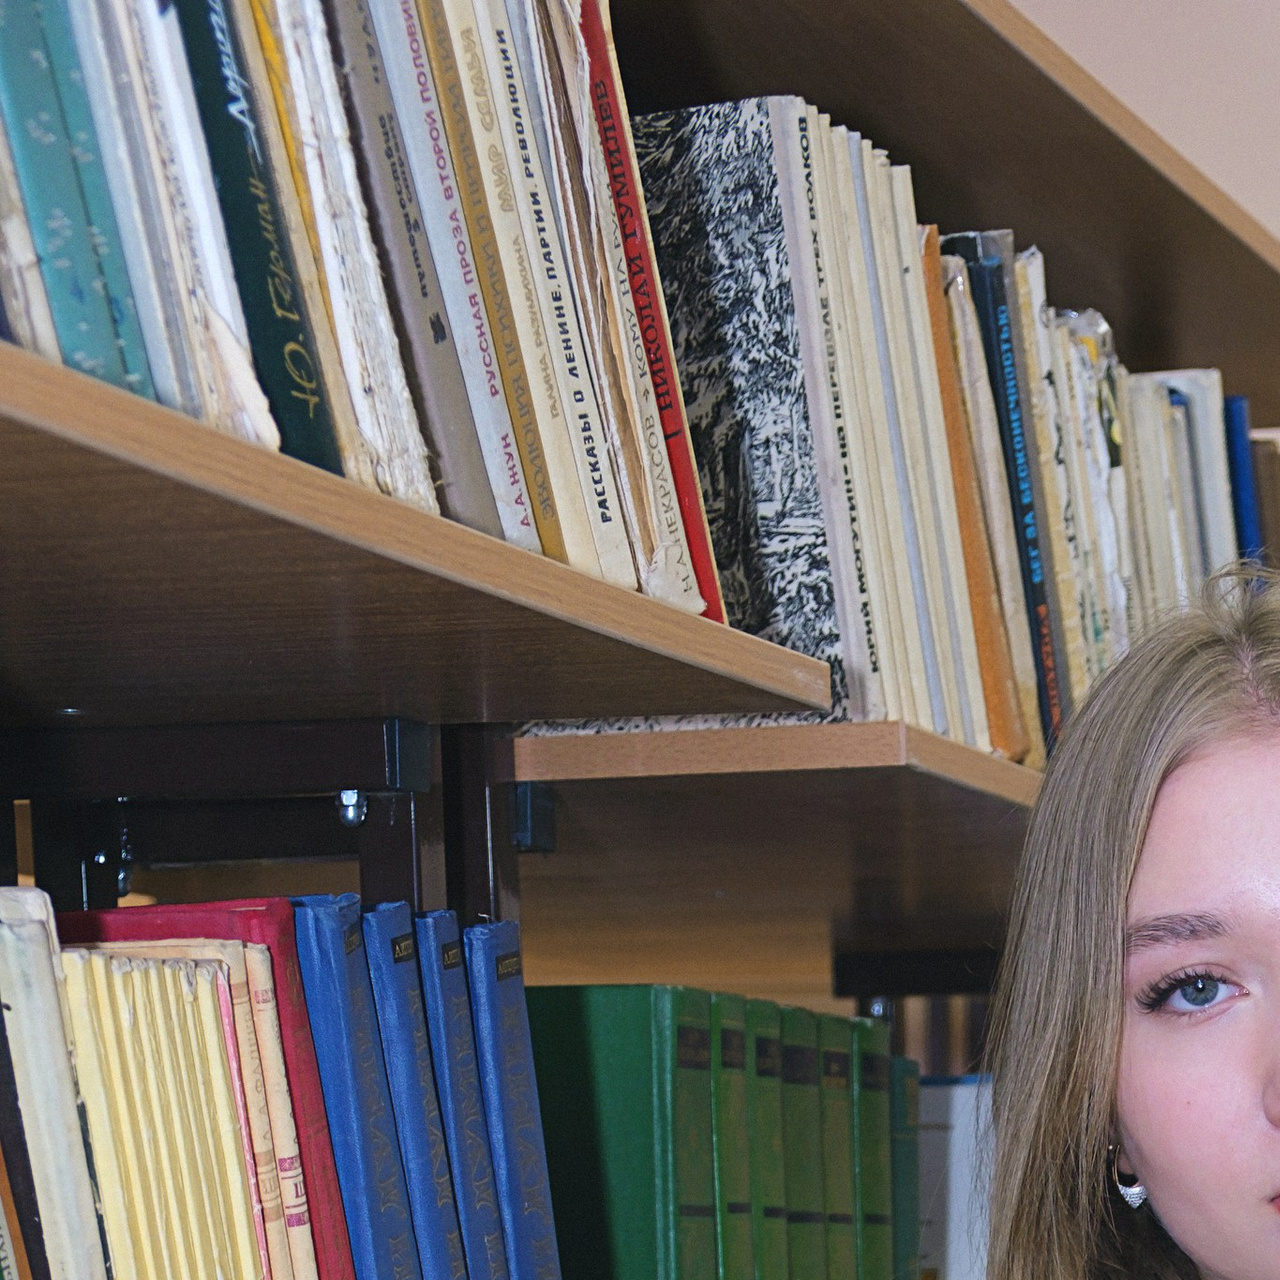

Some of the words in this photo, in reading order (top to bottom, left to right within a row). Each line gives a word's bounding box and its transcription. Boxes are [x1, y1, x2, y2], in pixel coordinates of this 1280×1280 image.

[458, 27, 494, 133] СЕМЬИ
[493, 27, 535, 179] РЕВОЛЮЦИИ
[422, 109, 456, 201] ВТОРОЙ
[486, 142, 513, 213] МИР
[594, 78, 638, 239] ГУМИЛЕВ
[794, 115, 818, 221] ВОЛКОВ
[249, 172, 298, 326] Герман
[446, 206, 476, 284] ПРОЗА
[509, 234, 544, 348] РАЗУМИХИНА
[613, 258, 630, 297] НА
[809, 227, 826, 289] ТРЕХ
[278, 331, 323, 420] Ю.
[465, 289, 500, 398] РУССКАЯ
[548, 282, 581, 381] ЛЕНИНЕ,
[622, 304, 649, 378] КОМУ
[627, 249, 673, 413] НИКОЛАЙ
[817, 294, 844, 419] ПЕРЕВАЛЕ
[537, 353, 560, 419] ГАЛИНА
[572, 390, 585, 403] О
[996, 304, 1032, 505] БЕСКОНЕЧНОСТЬЮ
[499, 432, 521, 485] ЖУК
[511, 373, 555, 519] ЭВОЛЮЦИЯ
[576, 412, 613, 524] РАССКАЗЫ
[842, 478, 868, 594] МОГУТИН
[1022, 511, 1037, 539] ЗА
[1027, 547, 1043, 583] БЕГ
[859, 599, 879, 674] ЮРИЙ
